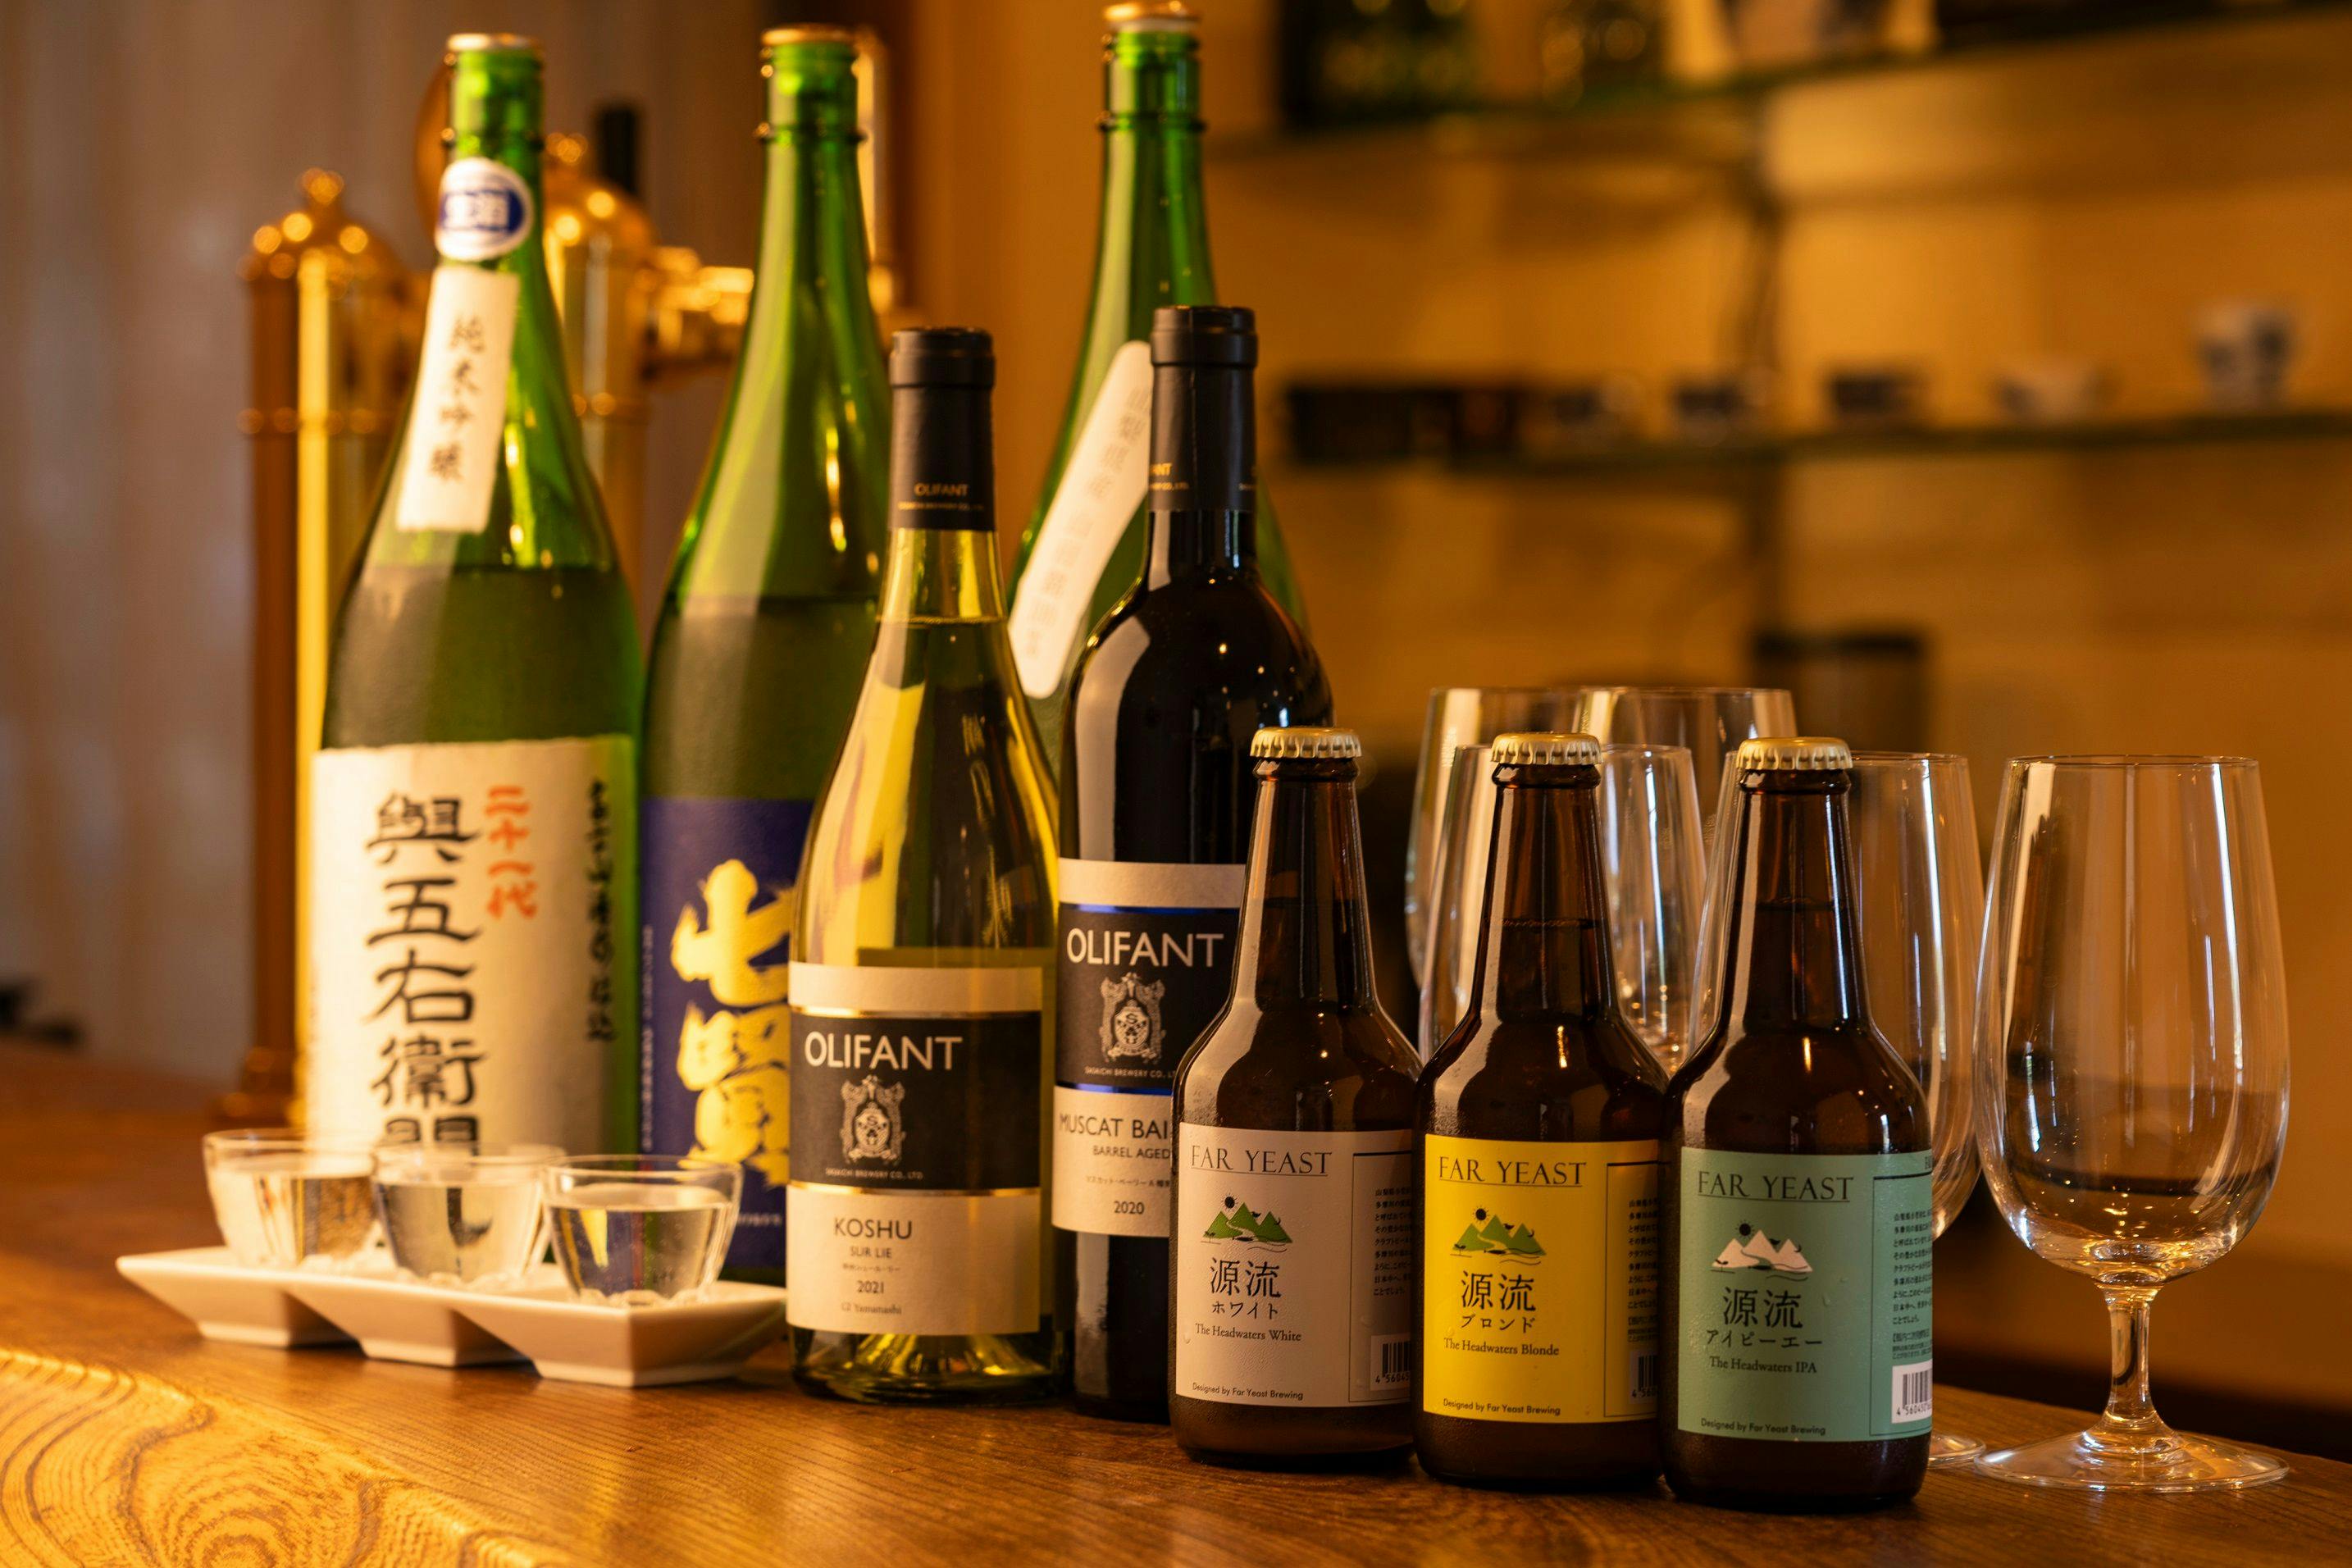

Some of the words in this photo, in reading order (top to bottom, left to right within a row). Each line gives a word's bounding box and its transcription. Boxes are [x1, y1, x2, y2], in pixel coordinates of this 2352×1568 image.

[1066, 928, 1224, 969] OLIFANT
[805, 1031, 963, 1070] OLIFANT
[1060, 1113, 1124, 1137] MUSCAT
[1092, 1145, 1133, 1158] BARREL
[1136, 1148, 1170, 1160] AGED
[1191, 1146, 1233, 1171] FAR
[1245, 1149, 1332, 1174] YEAST
[1439, 1156, 1484, 1182] FAR
[1497, 1160, 1587, 1185] YEAST
[1698, 1170, 1750, 1197] FAR
[1762, 1176, 1854, 1200] YEAST
[1114, 1200, 1145, 1215] 2020
[834, 1218, 912, 1240] KOSHU
[850, 1245, 871, 1257] SUR
[876, 1247, 892, 1259] LIE
[857, 1279, 885, 1294] 2021
[1210, 1257, 1282, 1298] 源流
[1461, 1270, 1536, 1311] 源流
[1212, 1301, 1279, 1320] ホワイト
[1722, 1286, 1803, 1329] 源流
[1195, 1323, 1210, 1336] The
[1212, 1325, 1266, 1341] Headwaters
[1269, 1329, 1302, 1342] White
[1461, 1315, 1536, 1333] ブロンド
[1443, 1337, 1460, 1351] The
[1462, 1339, 1518, 1355] Headwaters
[1521, 1343, 1559, 1356] Blonde
[1707, 1329, 1823, 1349] アイピーエー
[1710, 1356, 1729, 1370] The
[1730, 1358, 1793, 1374] Headwaters
[1795, 1361, 1817, 1374] IPA
[1374, 1374, 1380, 1383] 4
[1192, 1383, 1219, 1396] Designed
[1221, 1386, 1230, 1397] by
[1233, 1388, 1244, 1396] Far
[1247, 1388, 1268, 1397] Yeast
[1270, 1390, 1303, 1401] Brewing
[1443, 1397, 1474, 1411] Designed
[1475, 1402, 1484, 1412] by
[1487, 1402, 1500, 1412] Far
[1502, 1403, 1524, 1414] Yeast
[1526, 1405, 1561, 1415] Brewing
[1701, 1417, 1736, 1431] Designed
[1738, 1421, 1746, 1432] by
[1749, 1422, 1763, 1432] Far
[1765, 1423, 1789, 1434] Yeast
[1790, 1424, 1826, 1436] Brewing
